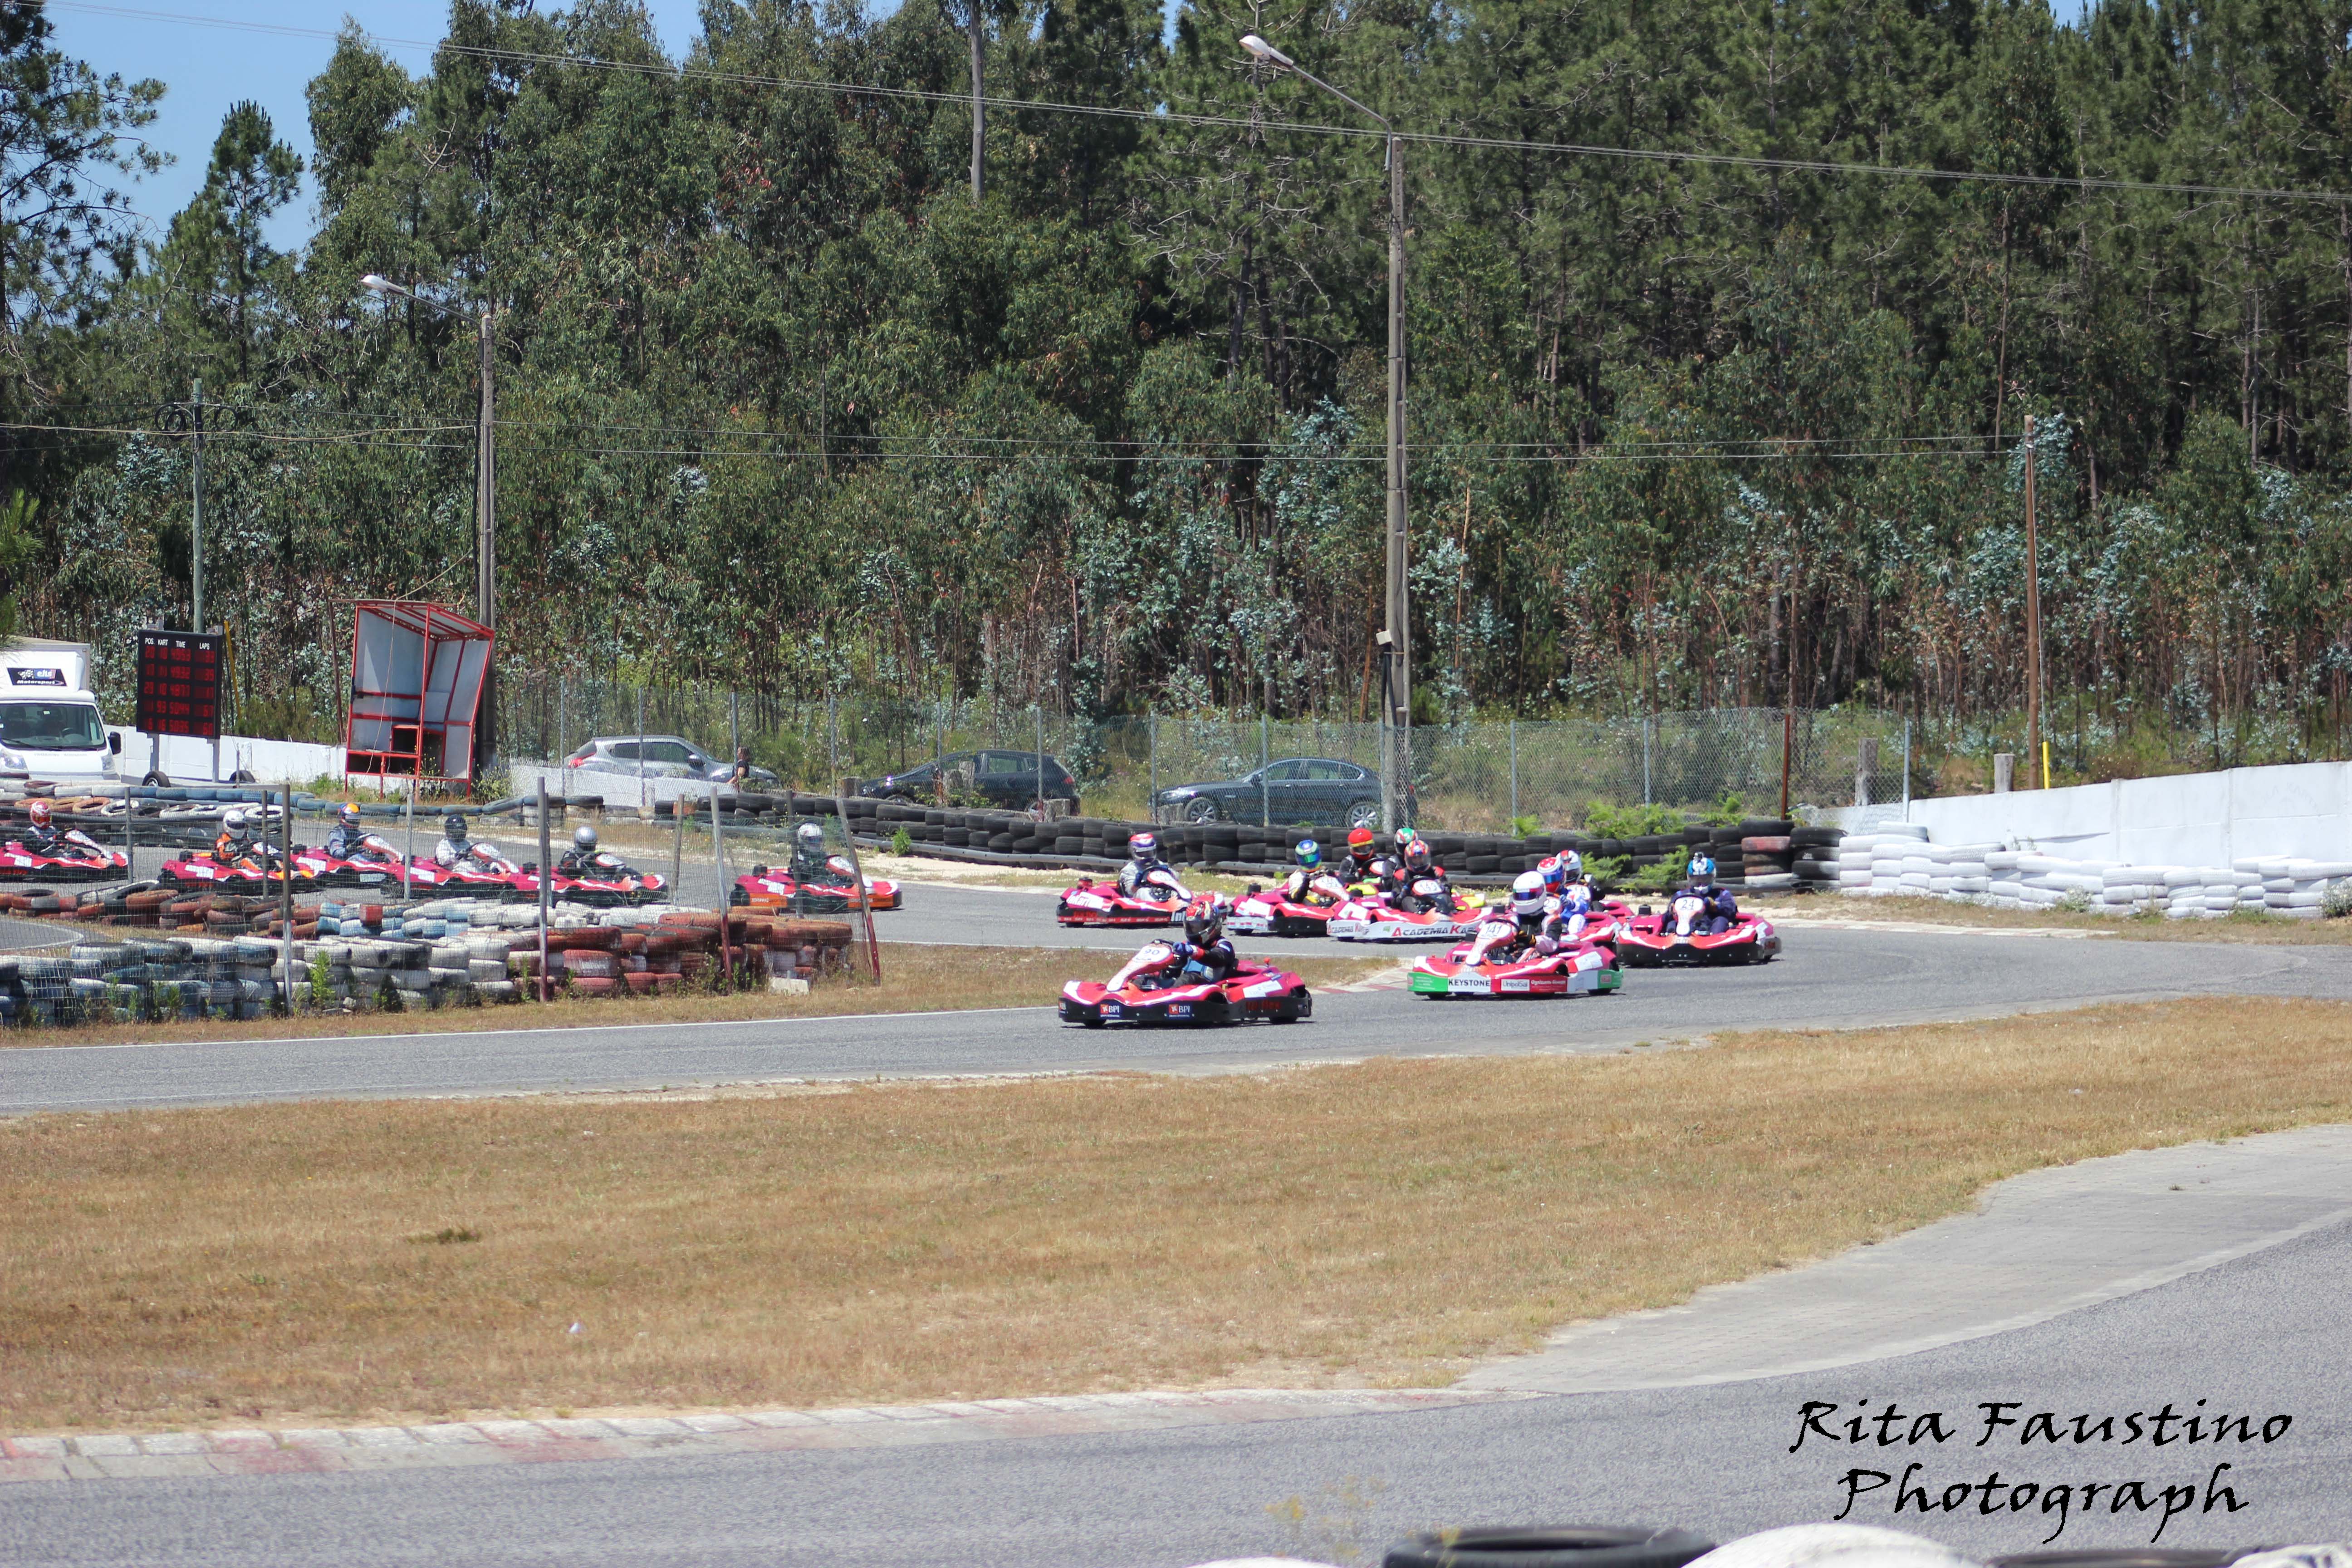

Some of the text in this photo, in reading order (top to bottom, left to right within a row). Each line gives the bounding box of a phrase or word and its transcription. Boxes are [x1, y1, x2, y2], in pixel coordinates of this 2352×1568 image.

[1681, 899, 1695, 910] 24
[1392, 927, 1448, 936] ACADEMIA
[1449, 979, 1490, 987] KEYSTONE
